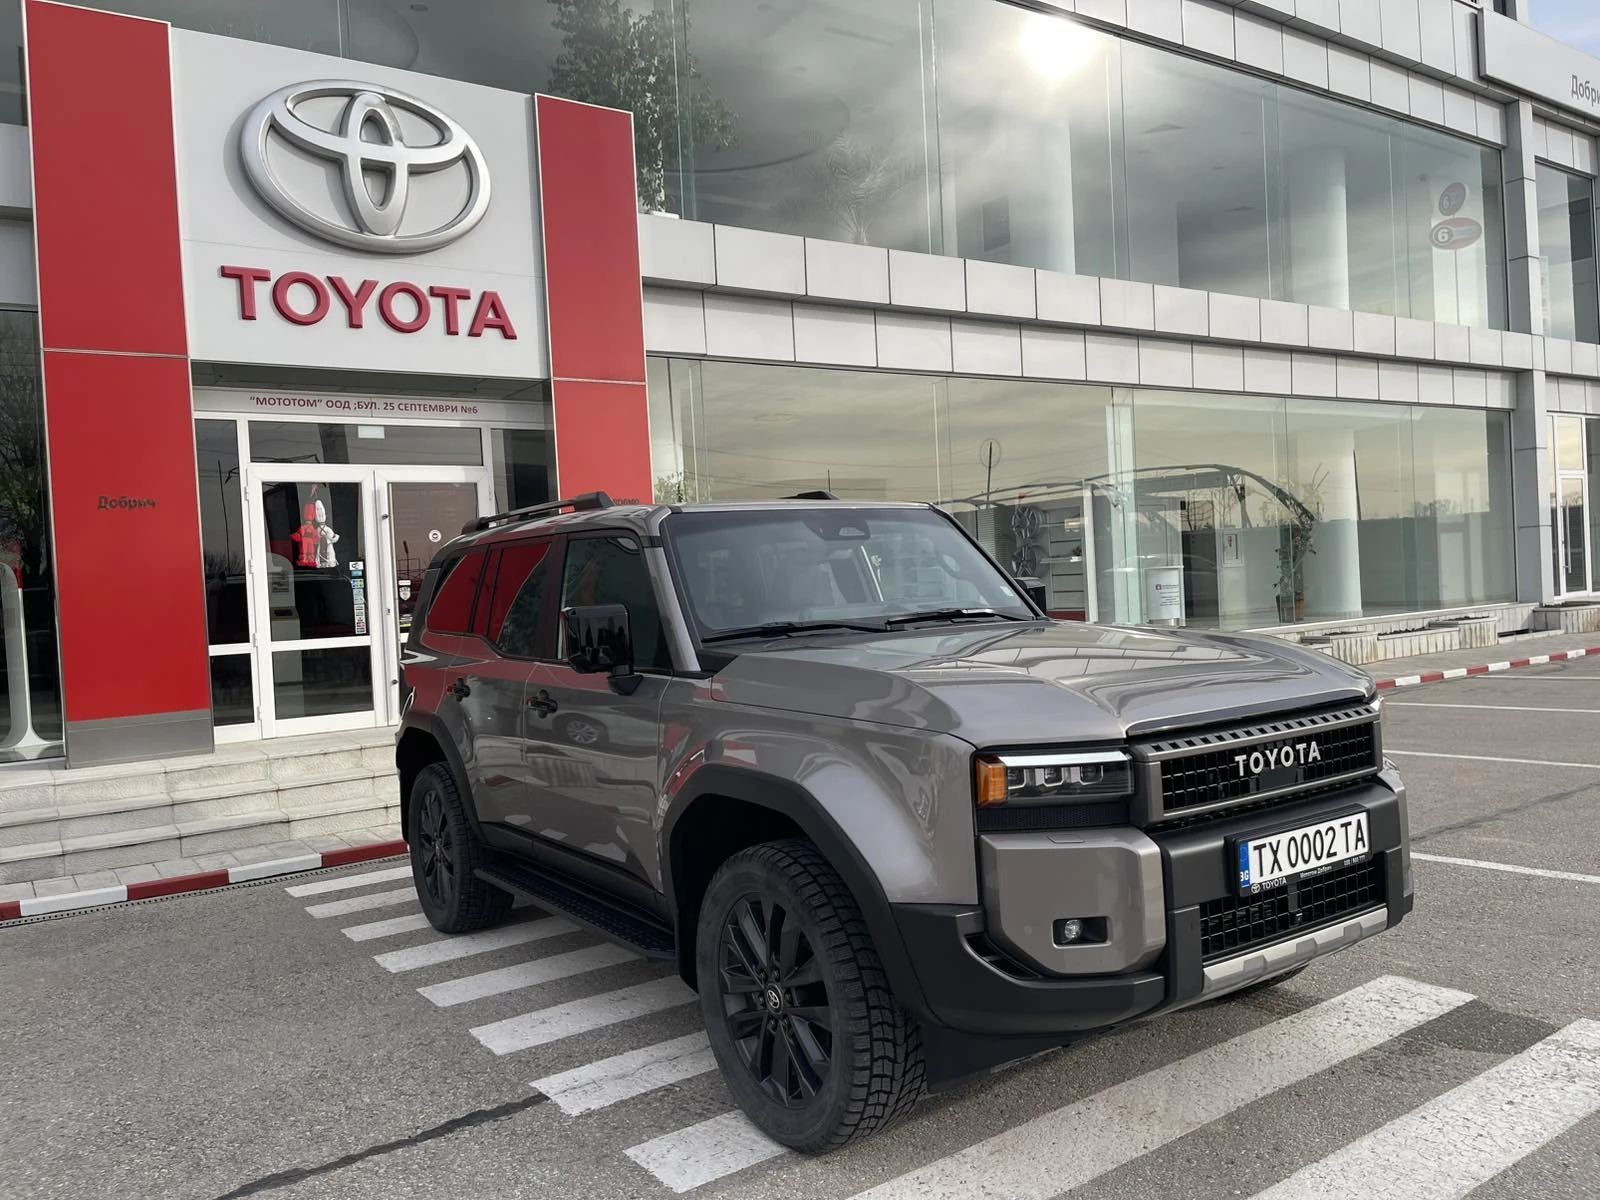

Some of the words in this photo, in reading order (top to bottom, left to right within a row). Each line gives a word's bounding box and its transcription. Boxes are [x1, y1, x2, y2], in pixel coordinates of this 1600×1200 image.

[1437, 229, 1449, 242] 6
[220, 265, 518, 340] TOYOTA
[325, 400, 351, 410] ООД
[383, 402, 395, 411] 25
[397, 403, 458, 413] СЕПТЕМВРИ
[460, 405, 478, 414] №6
[97, 495, 156, 511] Добрич
[1234, 741, 1322, 776] TOYOTA
[1253, 839, 1282, 877] TX
[1287, 826, 1338, 868] 0002
[1340, 818, 1366, 853] TA
[1261, 876, 1287, 890] TOYOTA
